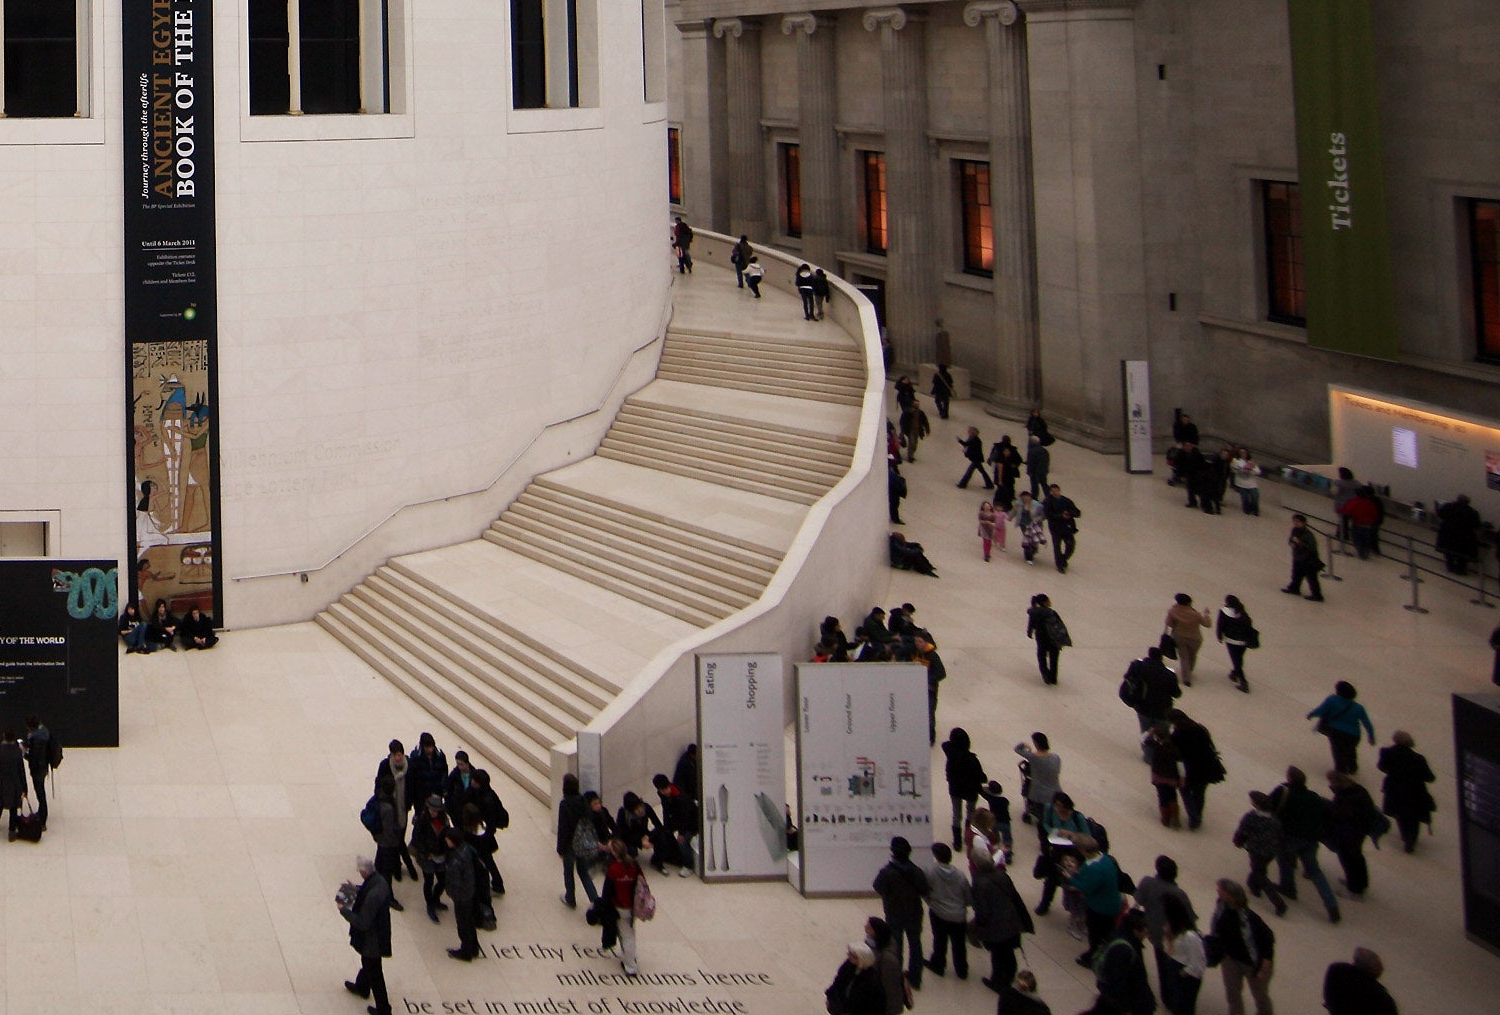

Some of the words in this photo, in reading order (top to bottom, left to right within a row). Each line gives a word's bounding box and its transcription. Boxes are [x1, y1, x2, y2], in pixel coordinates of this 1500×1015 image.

[175, 10, 194, 66] THE
[139, 72, 149, 109] afterlife
[175, 72, 195, 110] OF
[140, 110, 148, 124] the
[140, 125, 149, 162] through
[153, 73, 174, 199] ANCIENT
[175, 115, 195, 198] BOOK
[140, 162, 150, 199] Journey
[1327, 132, 1353, 231] Tickets
[36, 636, 66, 644] WORLD
[705, 662, 717, 695] Eating
[746, 661, 758, 709] Shopping
[491, 944, 525, 960] let
[528, 944, 564, 962] thy
[556, 969, 697, 986] millenniums
[698, 969, 775, 986] hence
[403, 998, 432, 1015] be
[441, 999, 479, 1015] set
[485, 998, 509, 1015] in
[513, 997, 583, 1015] midst
[588, 997, 612, 1015] of
[617, 996, 749, 1015] knowledge
